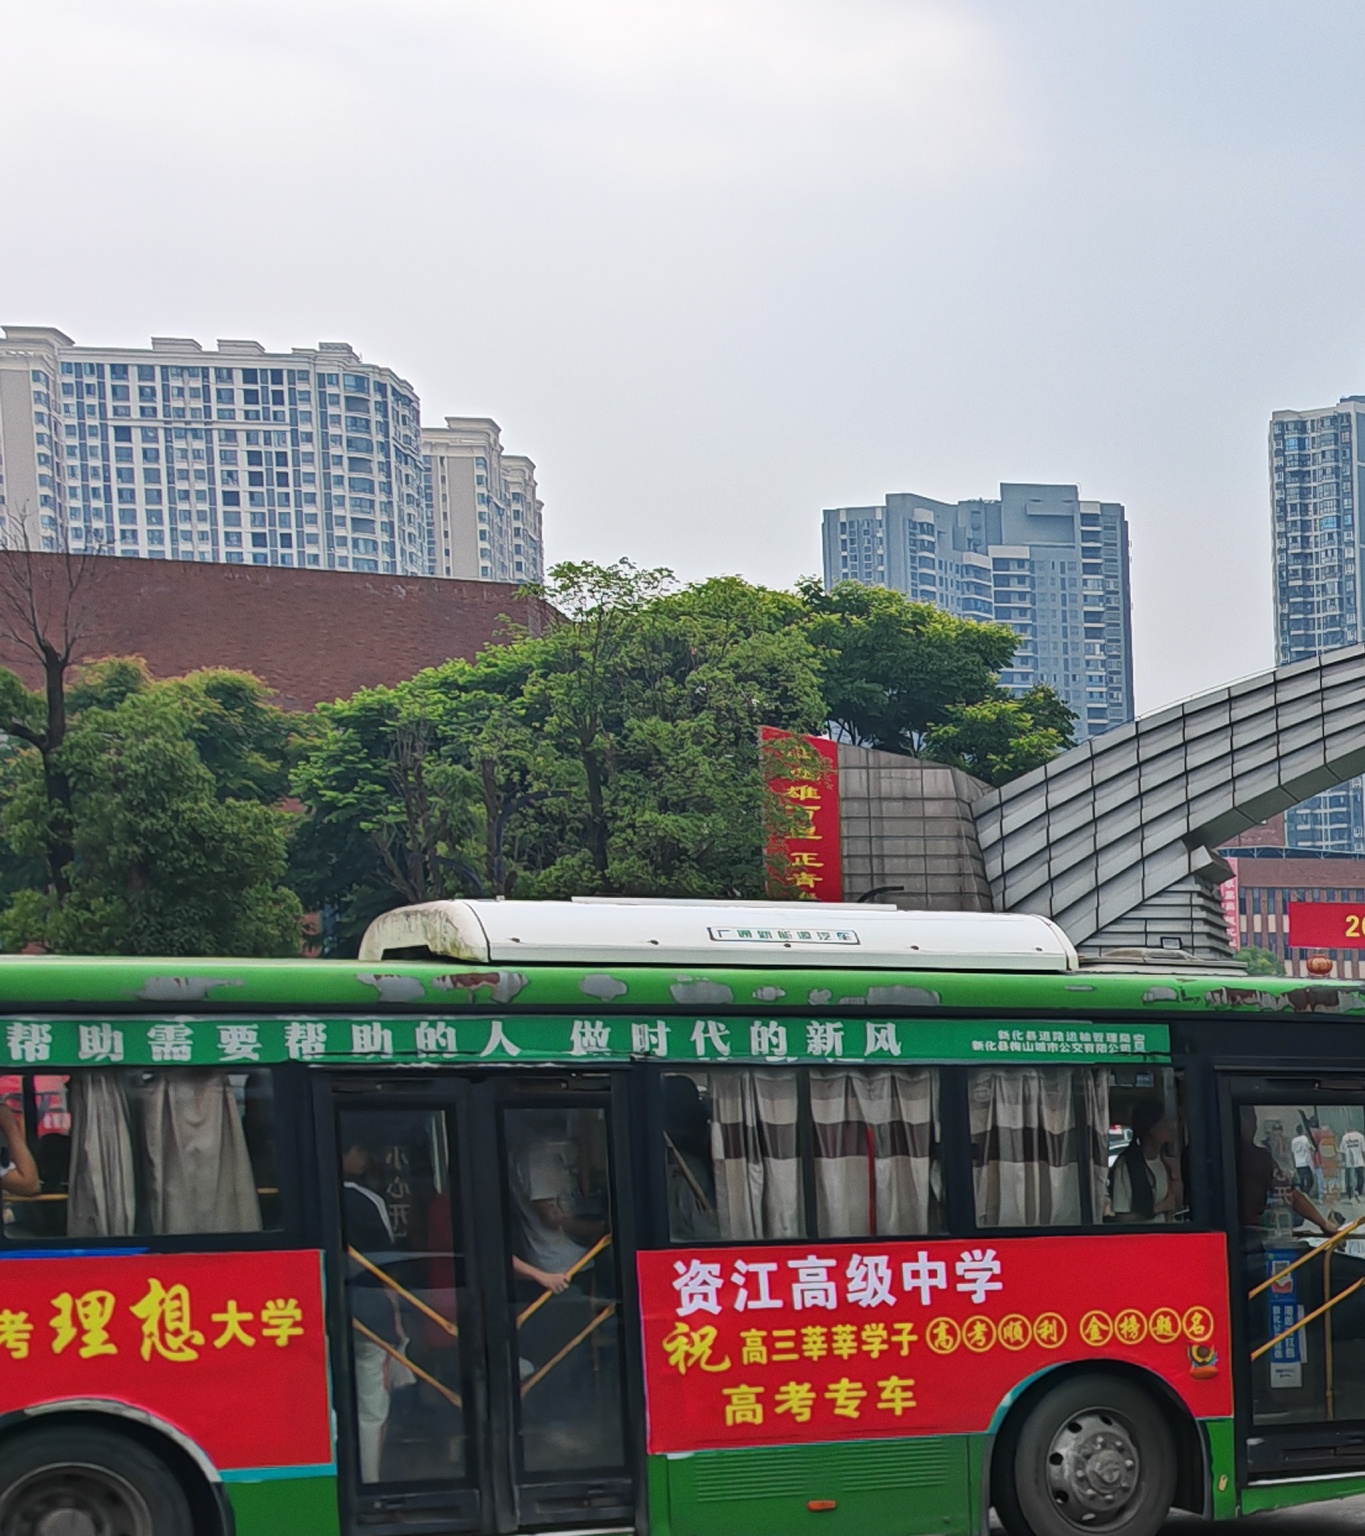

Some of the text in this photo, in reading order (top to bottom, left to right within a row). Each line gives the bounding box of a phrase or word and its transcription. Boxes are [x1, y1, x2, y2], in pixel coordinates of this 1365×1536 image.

[5, 1019, 903, 1062] 帮助需要帮助的人 做时代的新风
[672, 1249, 1004, 1316] 资江高级中学
[662, 1321, 732, 1375] 祝
[740, 1321, 919, 1366] 高三莘莘学子
[722, 1375, 918, 1426] 高考专车
